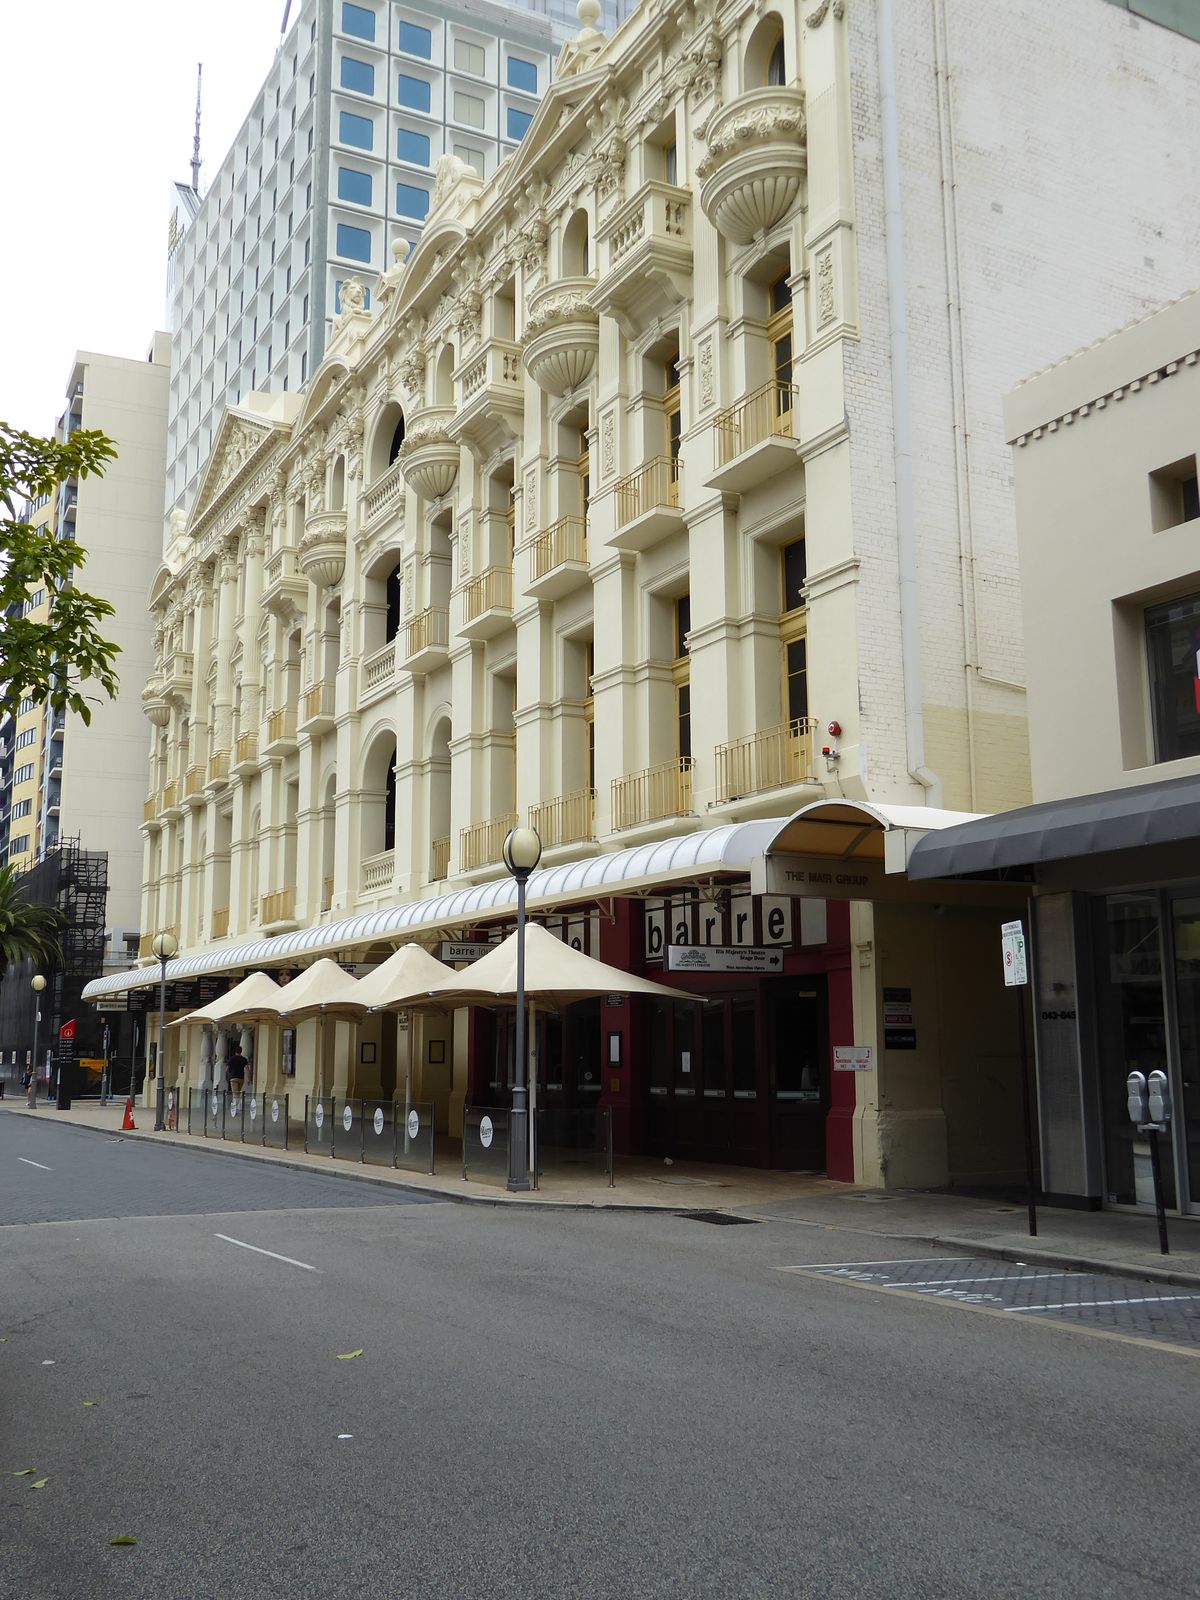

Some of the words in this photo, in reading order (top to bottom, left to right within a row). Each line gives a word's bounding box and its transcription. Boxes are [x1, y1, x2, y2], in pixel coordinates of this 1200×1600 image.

[785, 871, 804, 881] THE
[836, 873, 869, 886] GROUP
[648, 907, 784, 954] barre
[449, 946, 475, 956] barre
